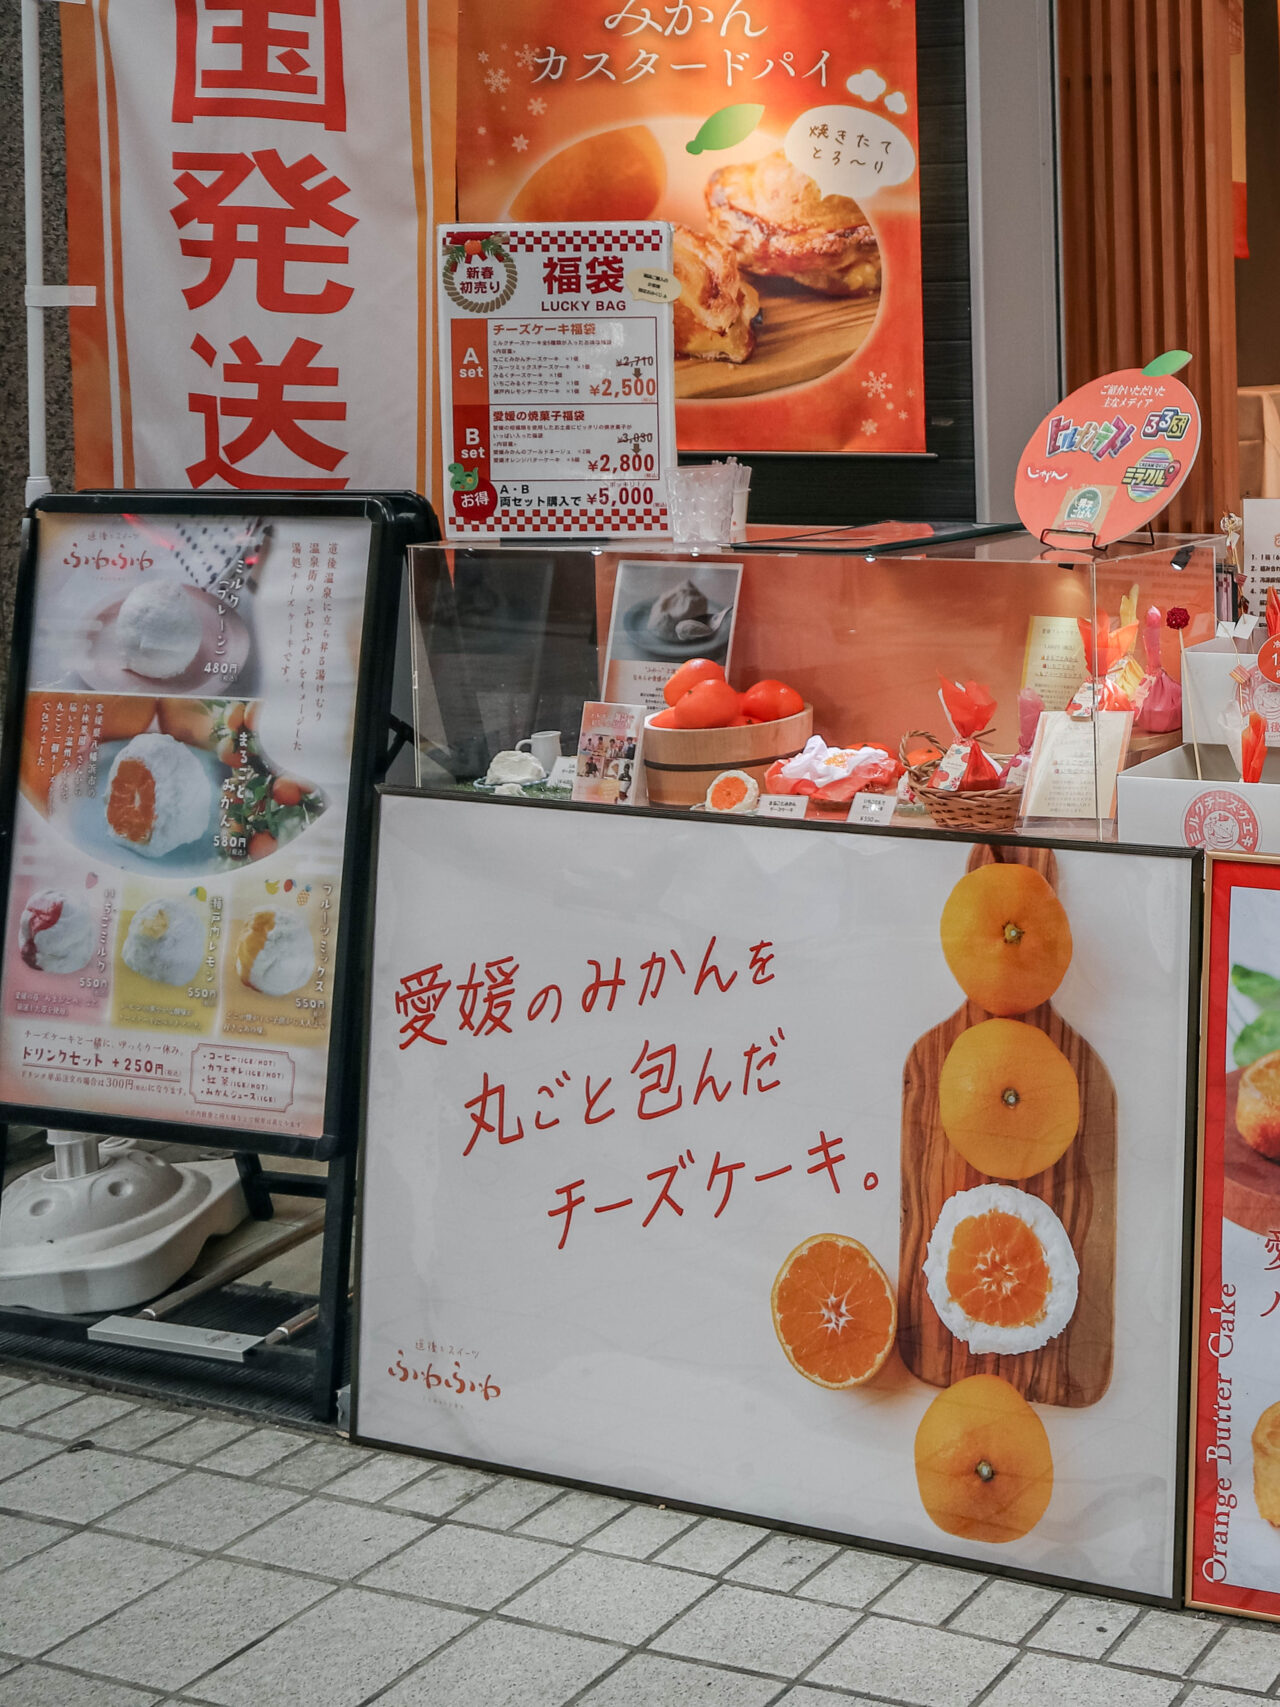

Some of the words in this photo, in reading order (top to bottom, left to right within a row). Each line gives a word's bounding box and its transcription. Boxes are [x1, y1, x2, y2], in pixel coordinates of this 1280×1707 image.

[603, 0, 768, 38] みかん
[531, 46, 835, 87] カスタードパイ
[808, 124, 893, 154] 焼きたて
[170, 0, 360, 489] 国発送
[466, 266, 494, 279] 新春
[543, 256, 624, 295] 福袋
[460, 281, 501, 294] 初売り
[541, 301, 590, 311] LUCKY
[596, 301, 626, 311] BAG
[493, 323, 596, 335] チーズケーキ福袋
[463, 348, 479, 364] A
[459, 366, 483, 378] set
[590, 378, 656, 396] ¥2,500
[1100, 384, 1166, 396] ご紹介いただいた
[1103, 399, 1153, 408] 主なメディア
[493, 411, 585, 421] 愛媛の焼菓子福袋
[466, 428, 480, 445] B
[461, 447, 485, 459] set
[588, 454, 654, 473] ¥2,800
[461, 491, 489, 508] お得
[500, 496, 581, 507] 両セット購入で
[586, 487, 654, 506] ¥5,000
[230, 560, 244, 608] ミルク
[204, 662, 238, 674] 480円
[237, 732, 248, 799] まるごと
[220, 779, 235, 827] みかん
[213, 836, 247, 847] 580円
[314, 884, 334, 992] フルーツミックス
[187, 988, 217, 998] 550円
[393, 935, 777, 1050] 愛媛のみかんを
[295, 998, 326, 1009] 550円
[23, 1046, 103, 1067] ドリンクセット
[462, 1027, 787, 1157] 丸ごと包んだ
[547, 1130, 879, 1250] チーズケーキ。
[1207, 1283, 1237, 1359] Cake
[1206, 1372, 1233, 1464] Butter
[1201, 1477, 1238, 1584] Orange
